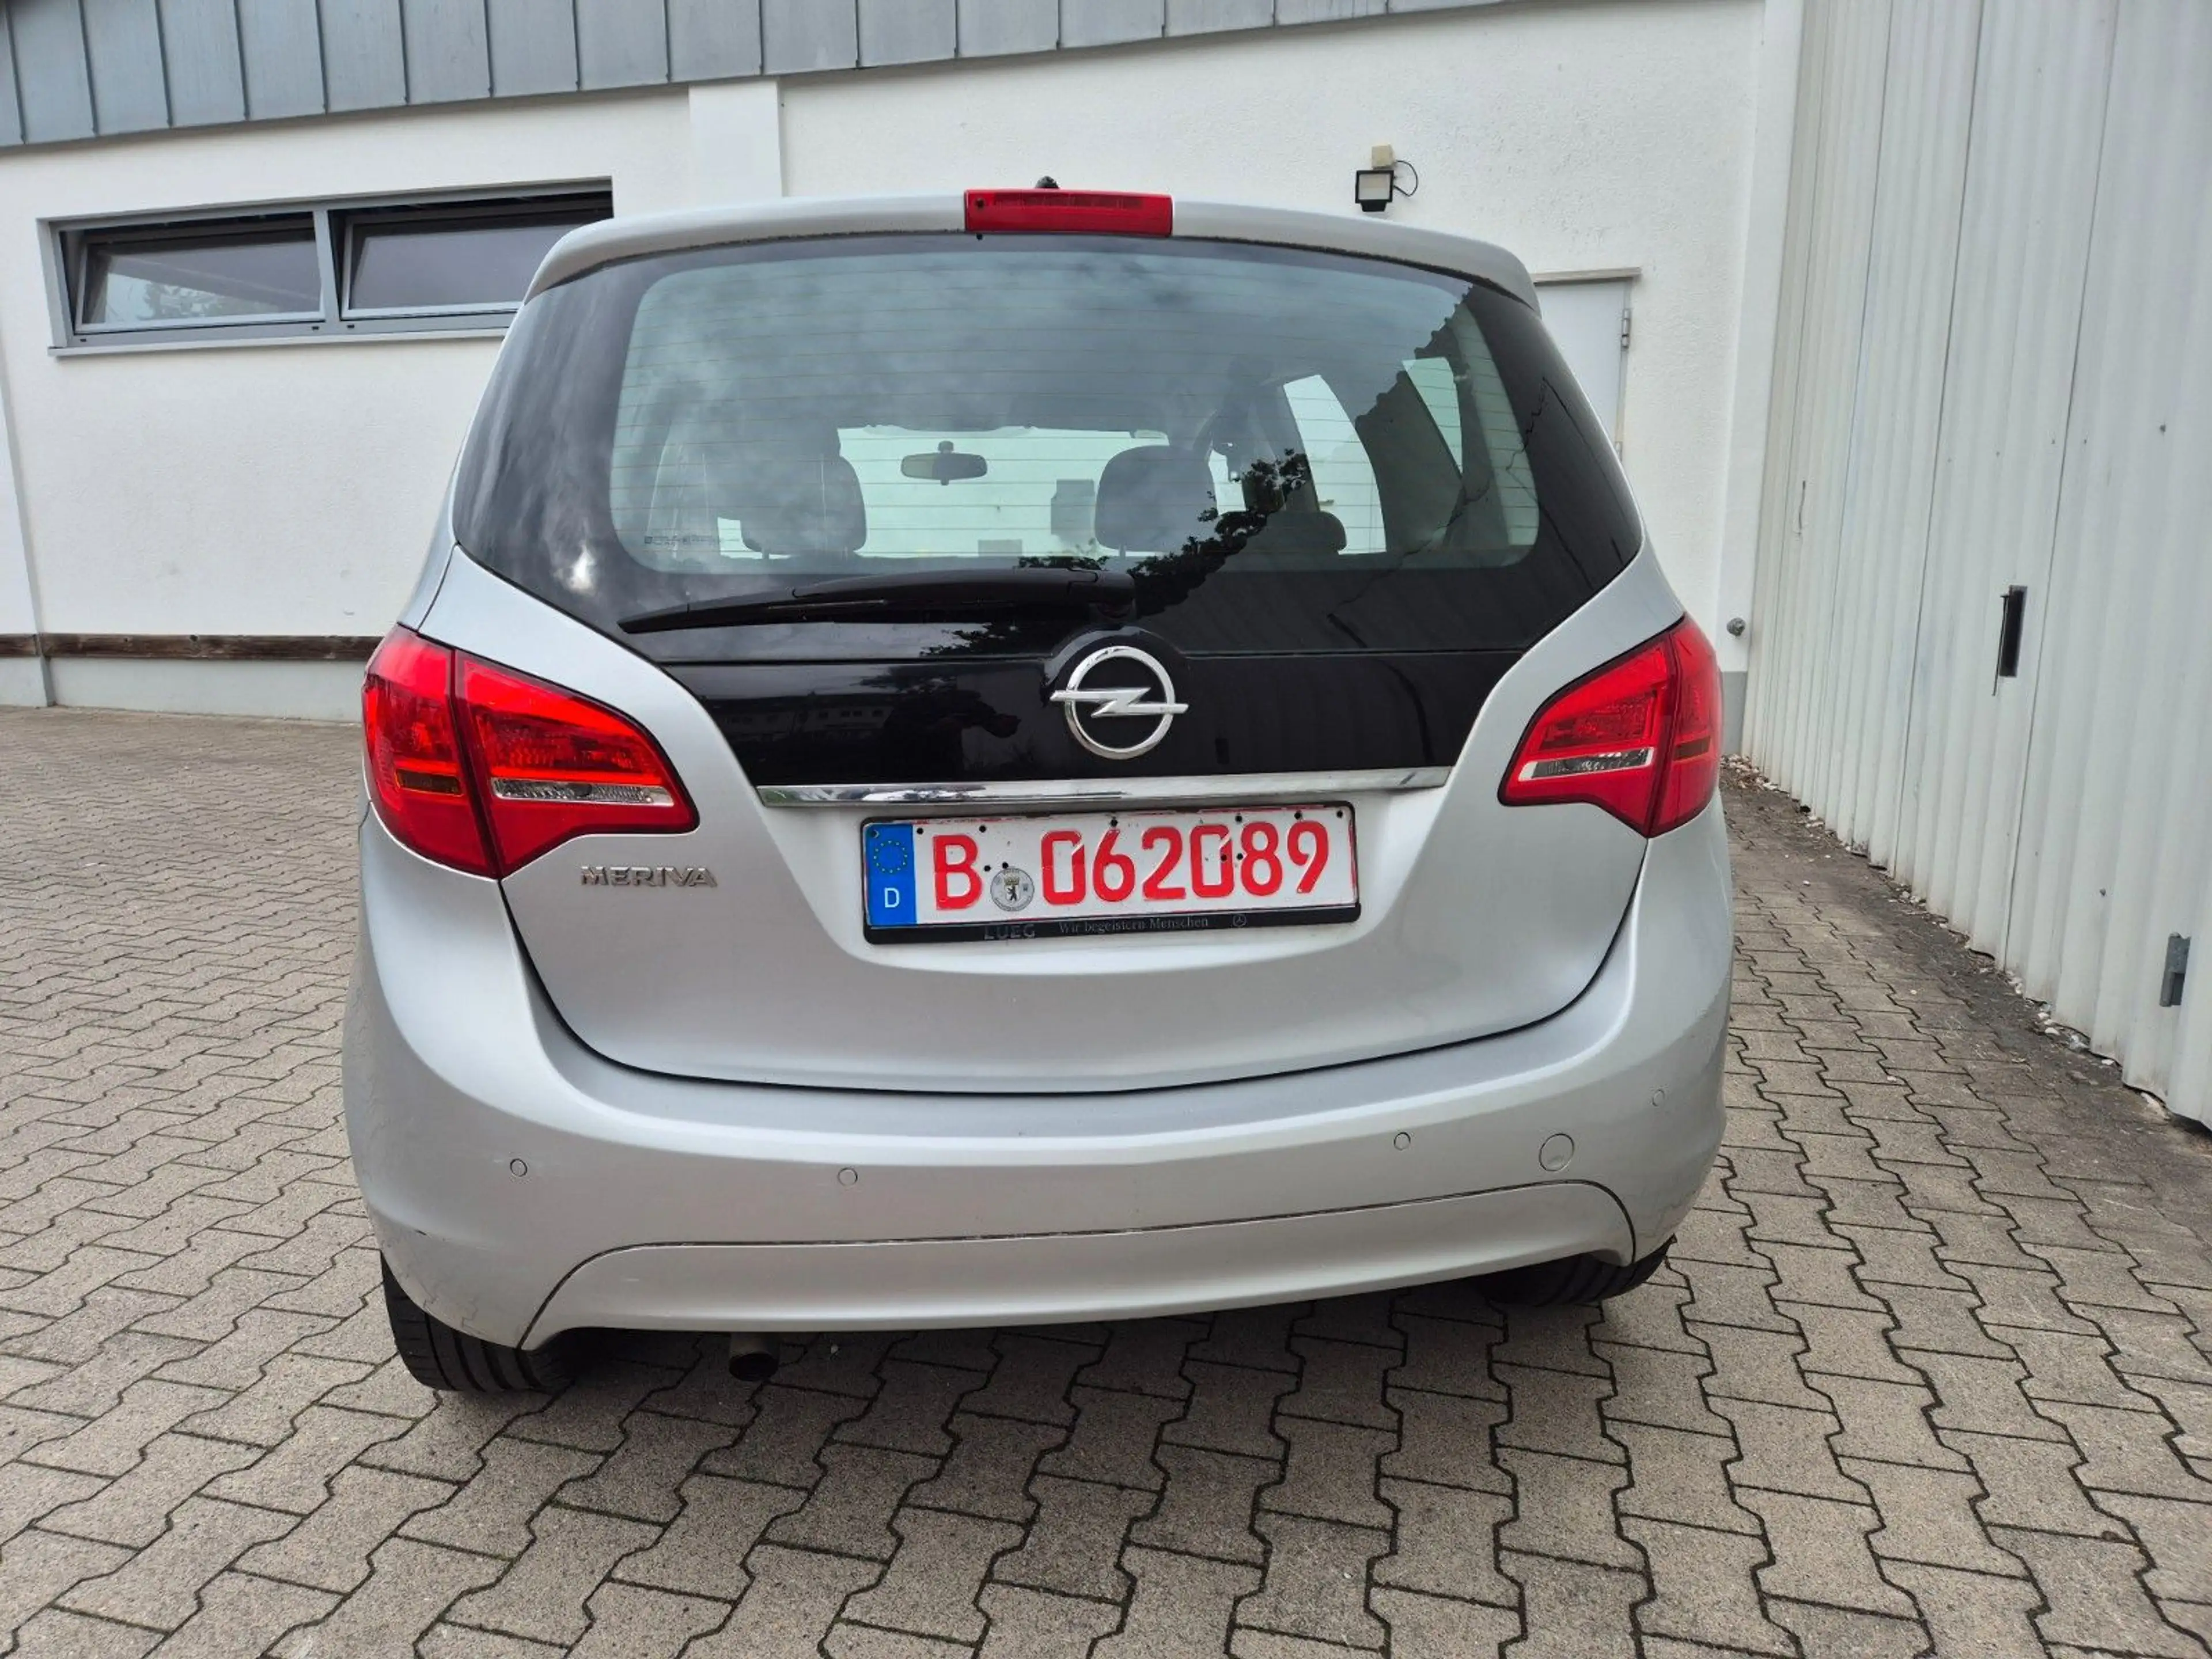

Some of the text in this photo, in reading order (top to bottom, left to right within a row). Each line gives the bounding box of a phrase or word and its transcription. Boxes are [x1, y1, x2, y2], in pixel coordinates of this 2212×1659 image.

[580, 865, 718, 888] MERIVA
[933, 820, 1330, 911] B 062089
[884, 887, 900, 908] D
[984, 923, 1035, 940] LUEG
[1059, 921, 1081, 934] Wir
[1150, 915, 1209, 929] Menschen
